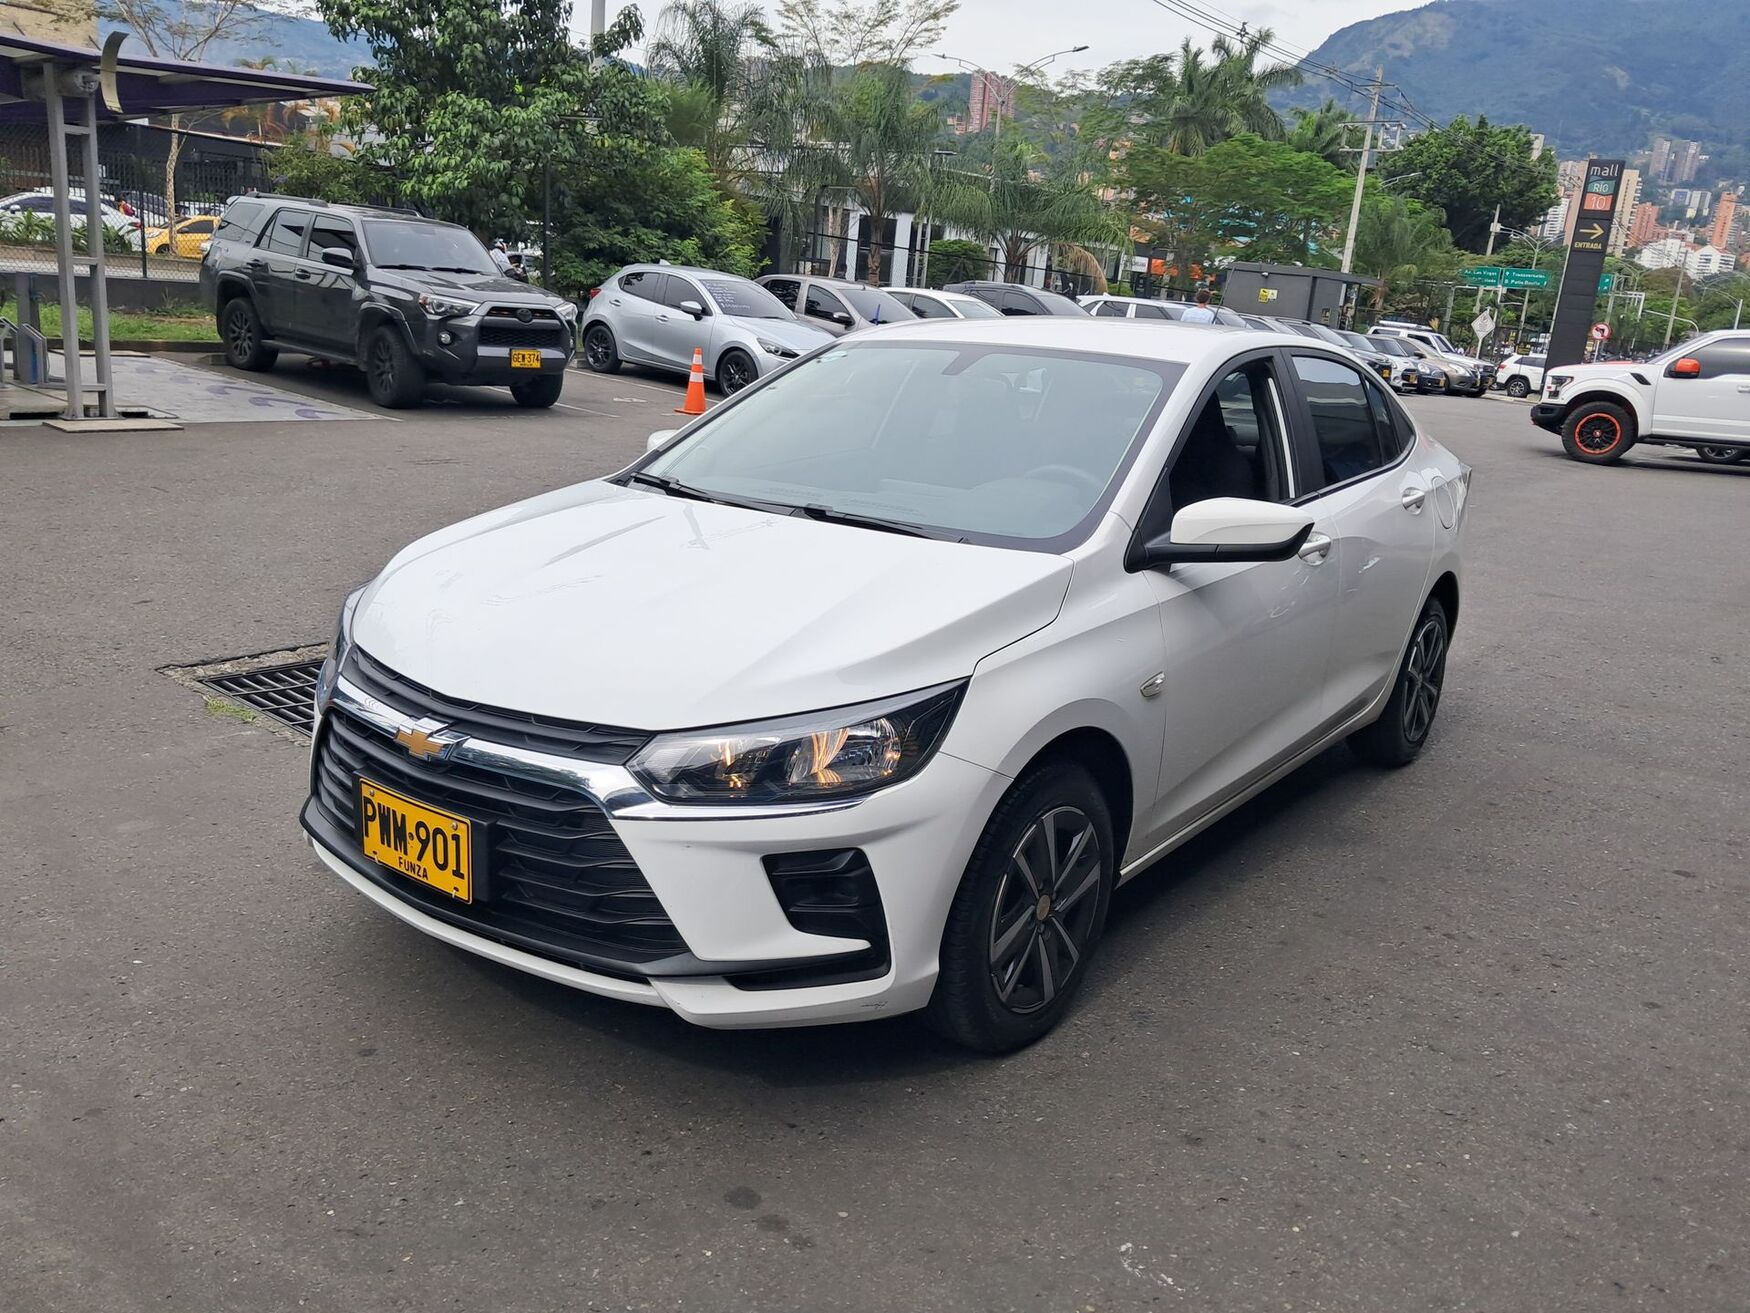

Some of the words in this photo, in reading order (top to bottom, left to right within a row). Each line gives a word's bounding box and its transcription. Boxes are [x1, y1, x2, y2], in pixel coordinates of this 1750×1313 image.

[1590, 164, 1619, 177] mall
[1591, 196, 1606, 209] 10
[1574, 241, 1602, 250] ENTRADA
[398, 856, 429, 881] FUNZA
